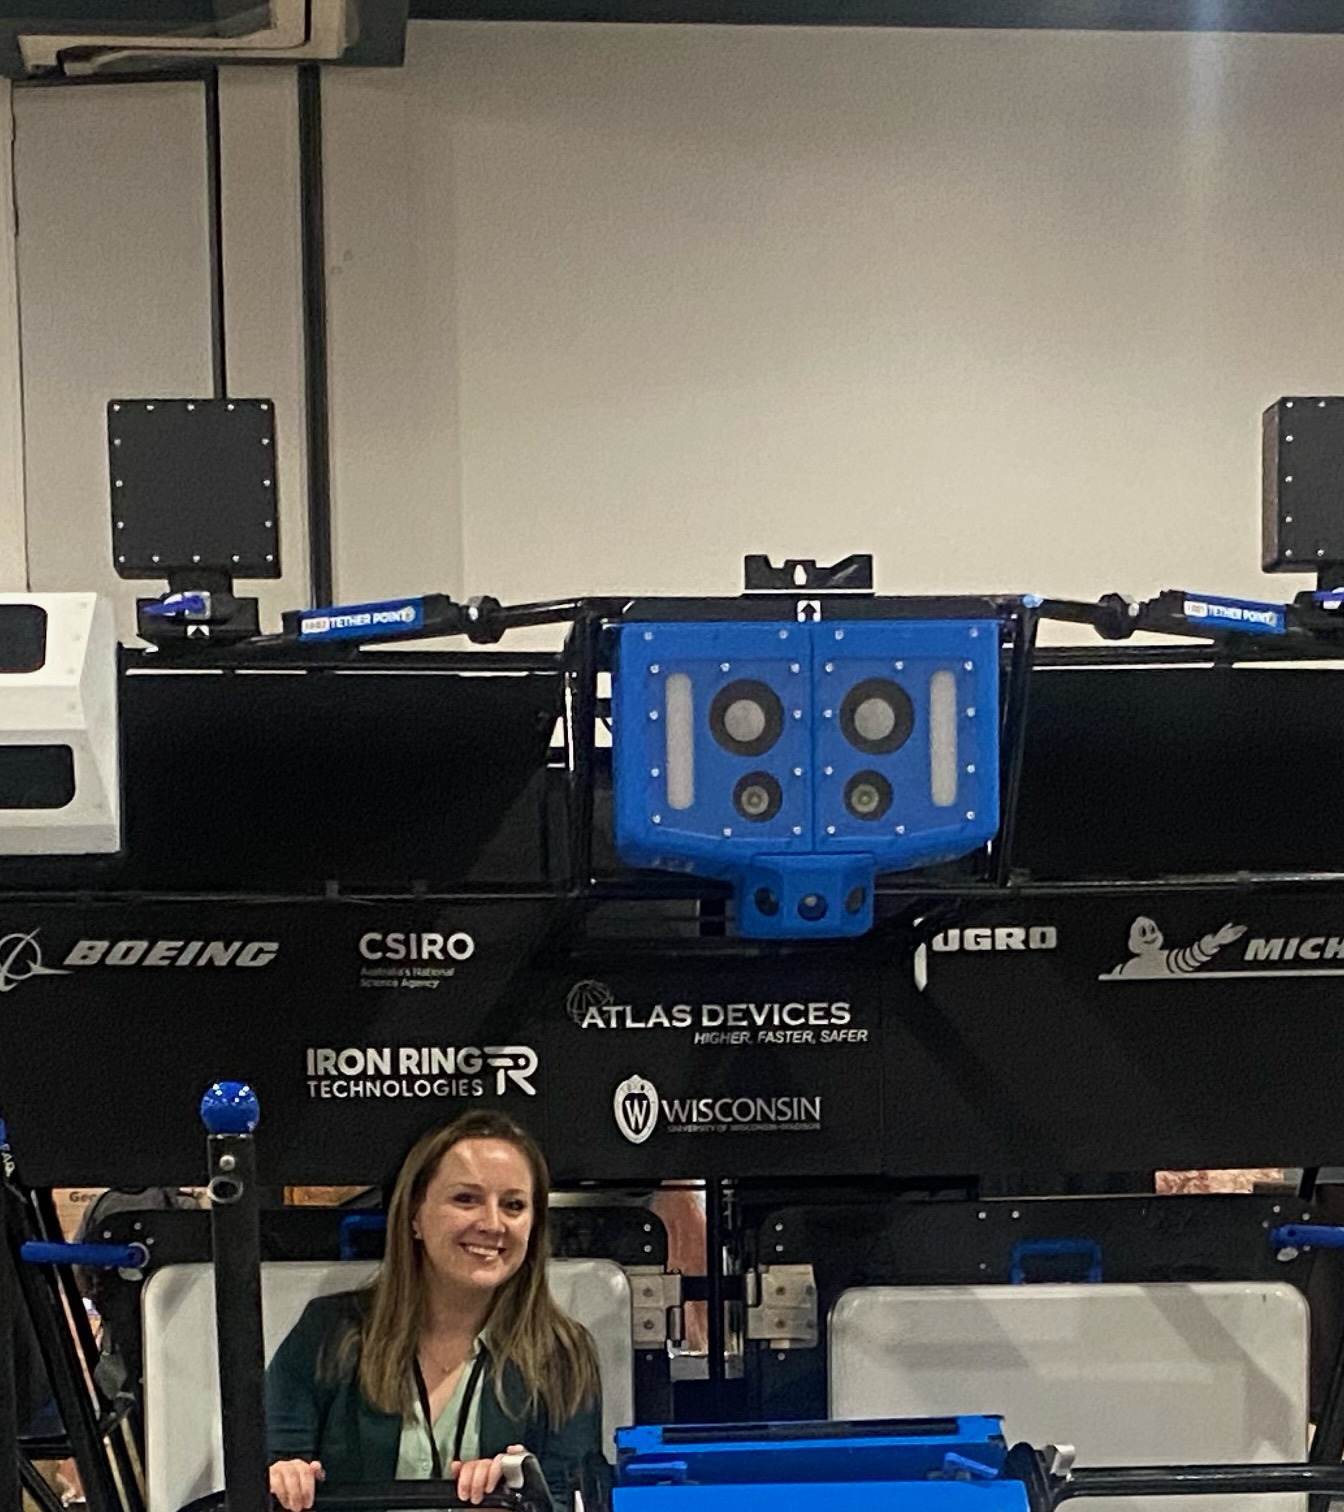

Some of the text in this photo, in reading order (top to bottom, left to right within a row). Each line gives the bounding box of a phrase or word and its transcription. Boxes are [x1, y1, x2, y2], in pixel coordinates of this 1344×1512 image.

[62, 940, 280, 967] BOEING
[358, 932, 475, 960] CSIRO
[581, 1002, 852, 1028] ATLAS DEVICES
[819, 1029, 868, 1043] SAFER
[306, 1048, 392, 1076] IRON
[398, 1046, 484, 1075] RING
[306, 1079, 484, 1098] TECHNOLOGIES
[661, 1096, 821, 1123] WISCONSIN
